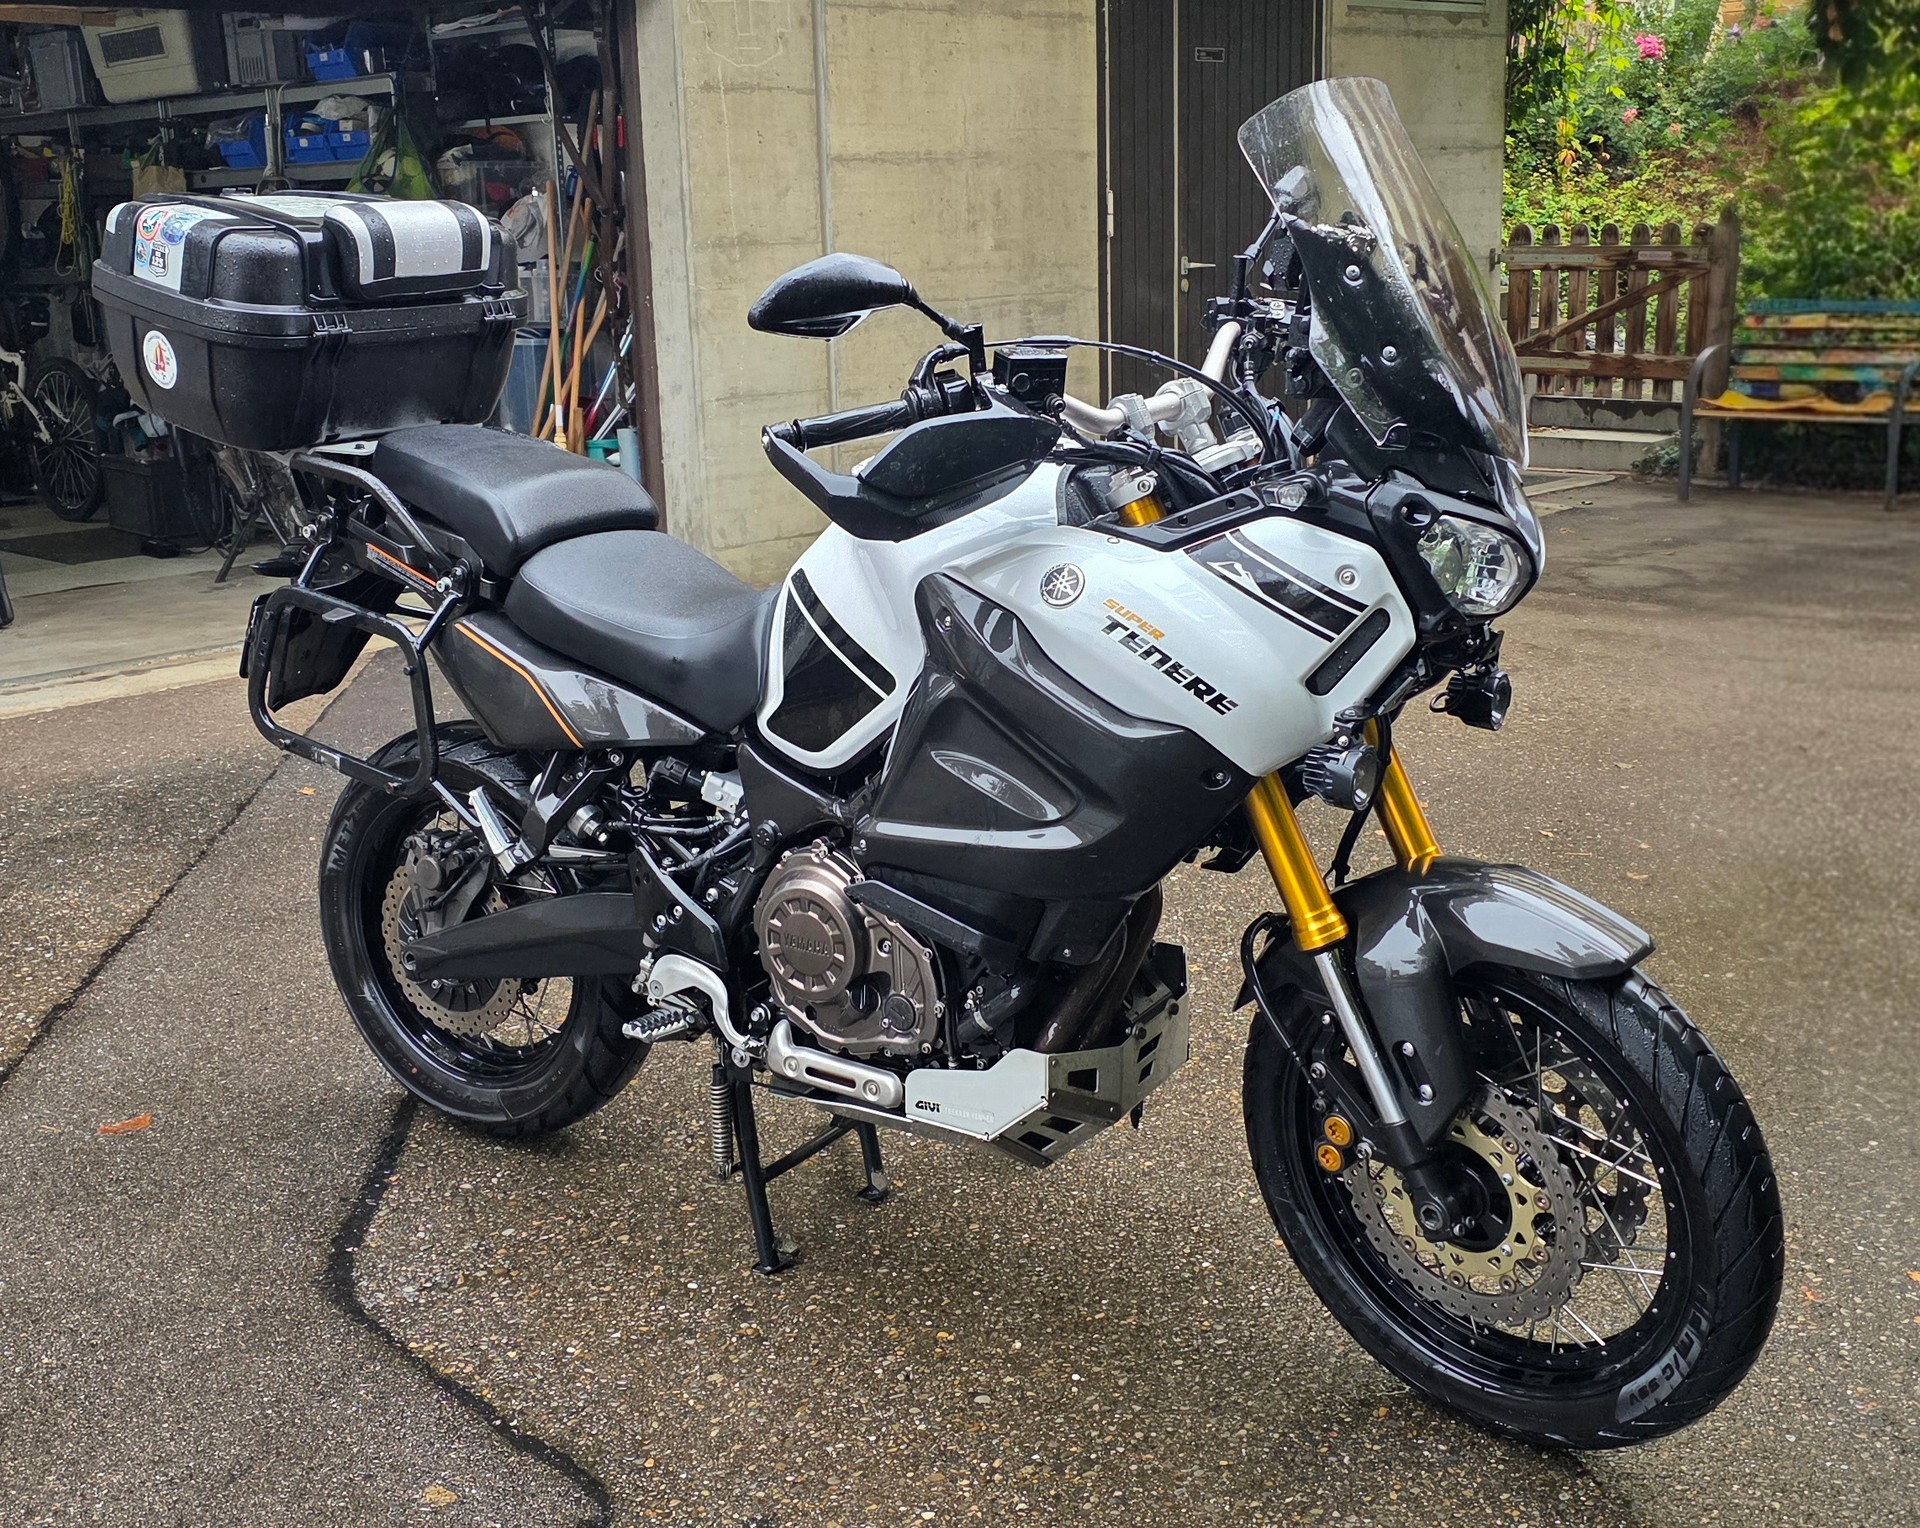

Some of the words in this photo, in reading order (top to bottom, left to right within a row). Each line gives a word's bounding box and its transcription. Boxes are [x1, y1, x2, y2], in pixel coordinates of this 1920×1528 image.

[1102, 597, 1166, 641] SUPER
[1100, 614, 1240, 716] TENERE
[783, 931, 831, 957] YAMAHA
[914, 1099, 942, 1113] GIVI
